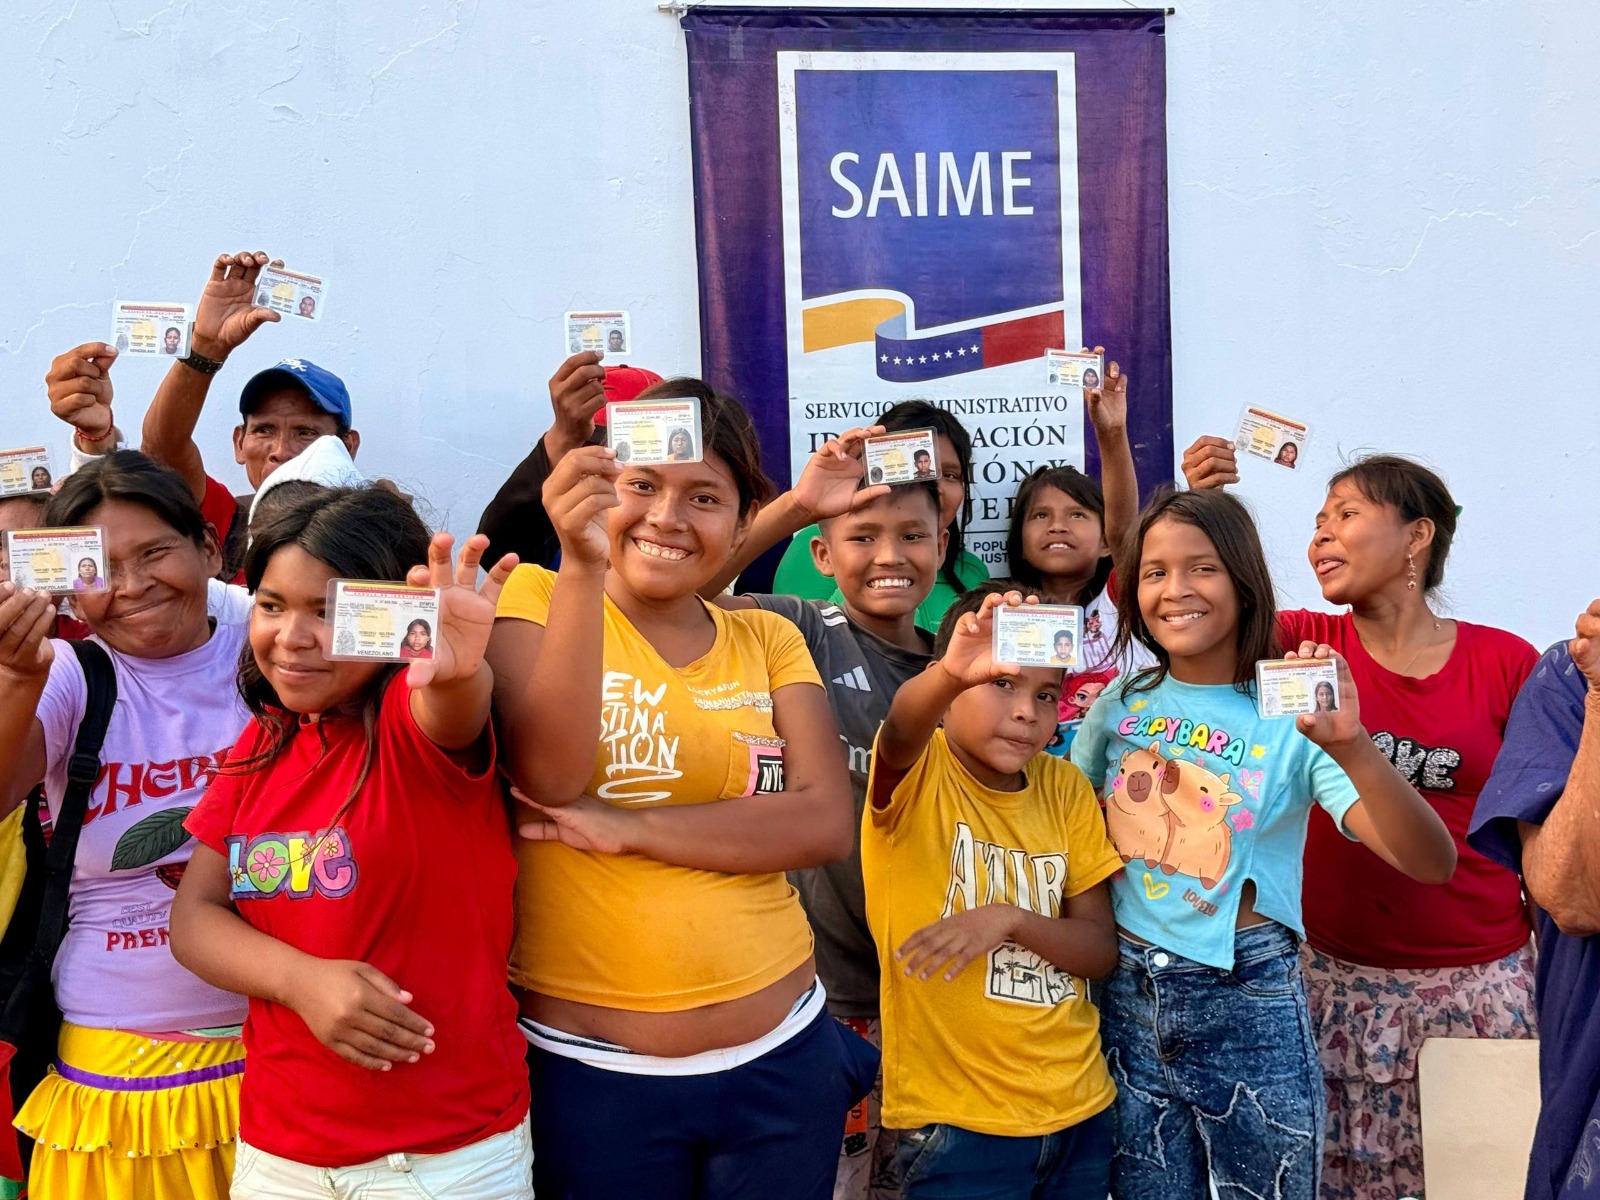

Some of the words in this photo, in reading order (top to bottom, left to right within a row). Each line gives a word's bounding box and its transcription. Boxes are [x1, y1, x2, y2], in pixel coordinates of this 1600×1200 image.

[829, 151, 1034, 218] SAIME
[805, 401, 895, 419] SERVICIO
[1118, 716, 1245, 766] CAPYBARA
[82, 746, 233, 827] CHER
[761, 764, 784, 792] NYC
[225, 827, 358, 899] LOVE
